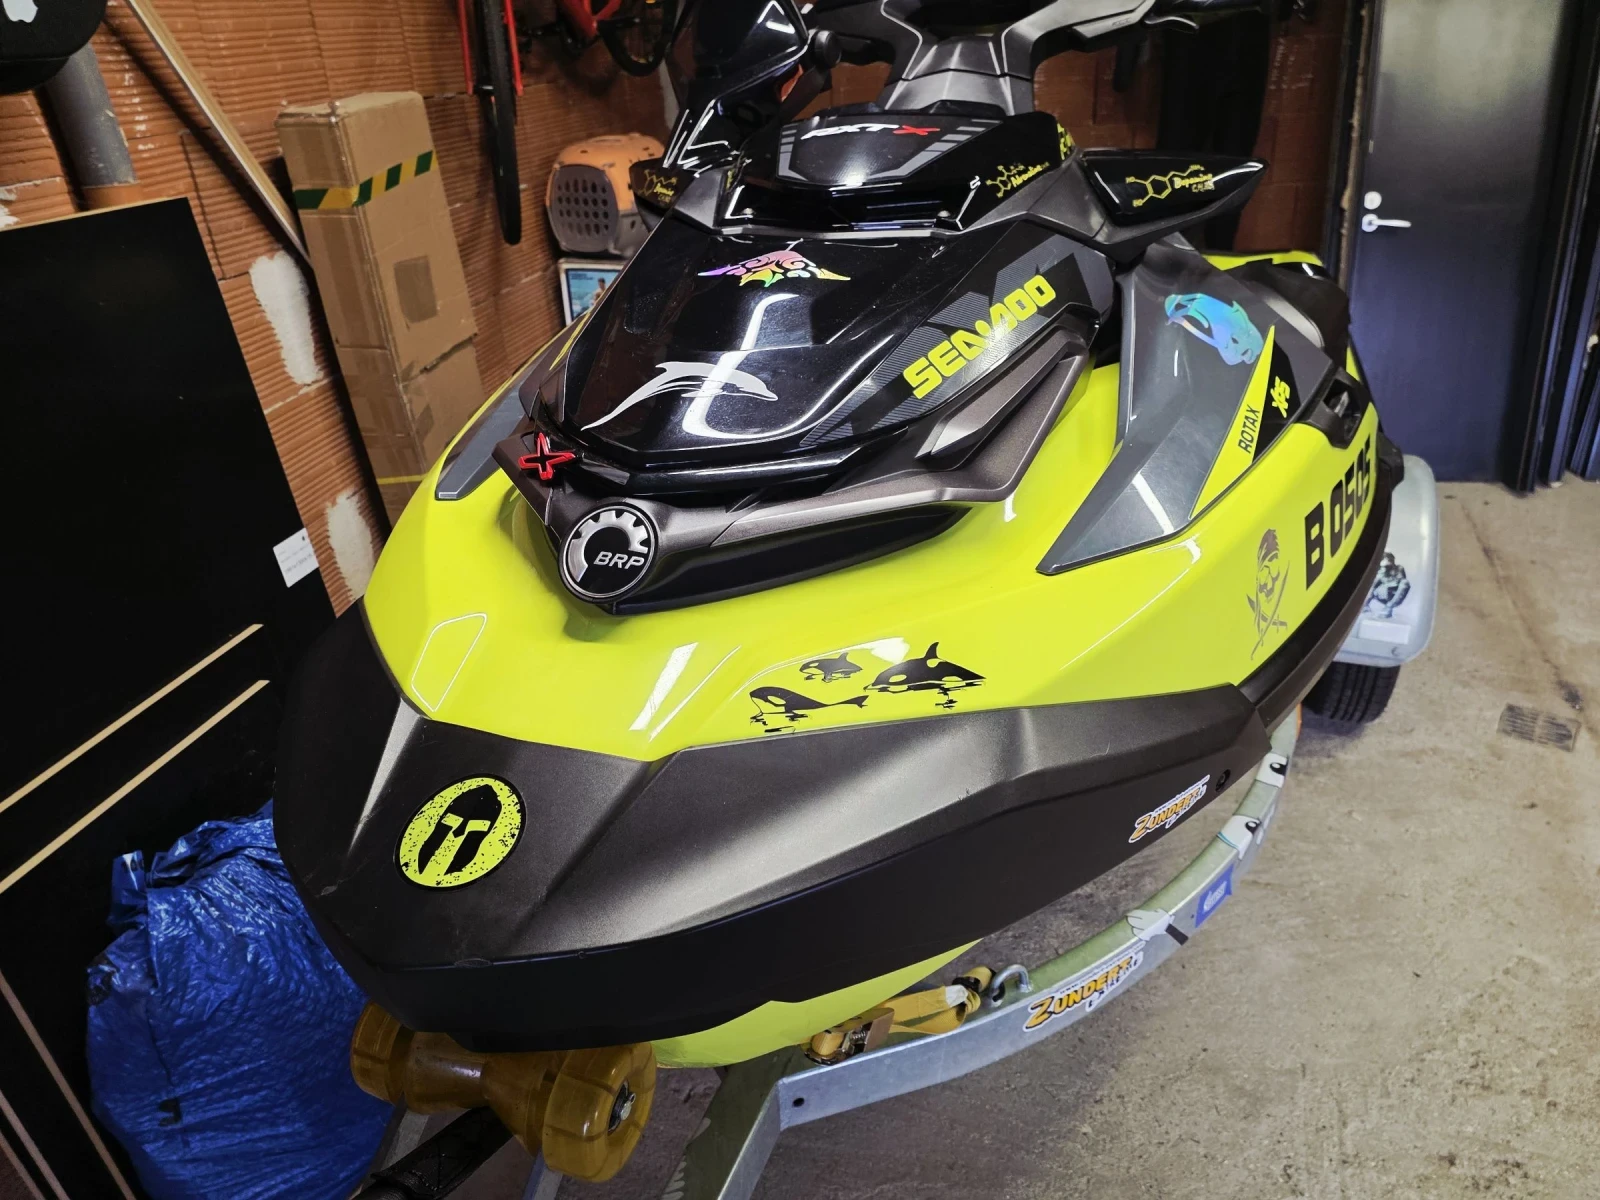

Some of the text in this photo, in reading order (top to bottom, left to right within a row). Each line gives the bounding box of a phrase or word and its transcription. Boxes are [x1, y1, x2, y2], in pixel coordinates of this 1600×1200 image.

[1238, 404, 1261, 454] ROTAX
[593, 551, 645, 569] BRP
[1304, 501, 1325, 591] B
[1025, 956, 1133, 1029] ZUNDERT
